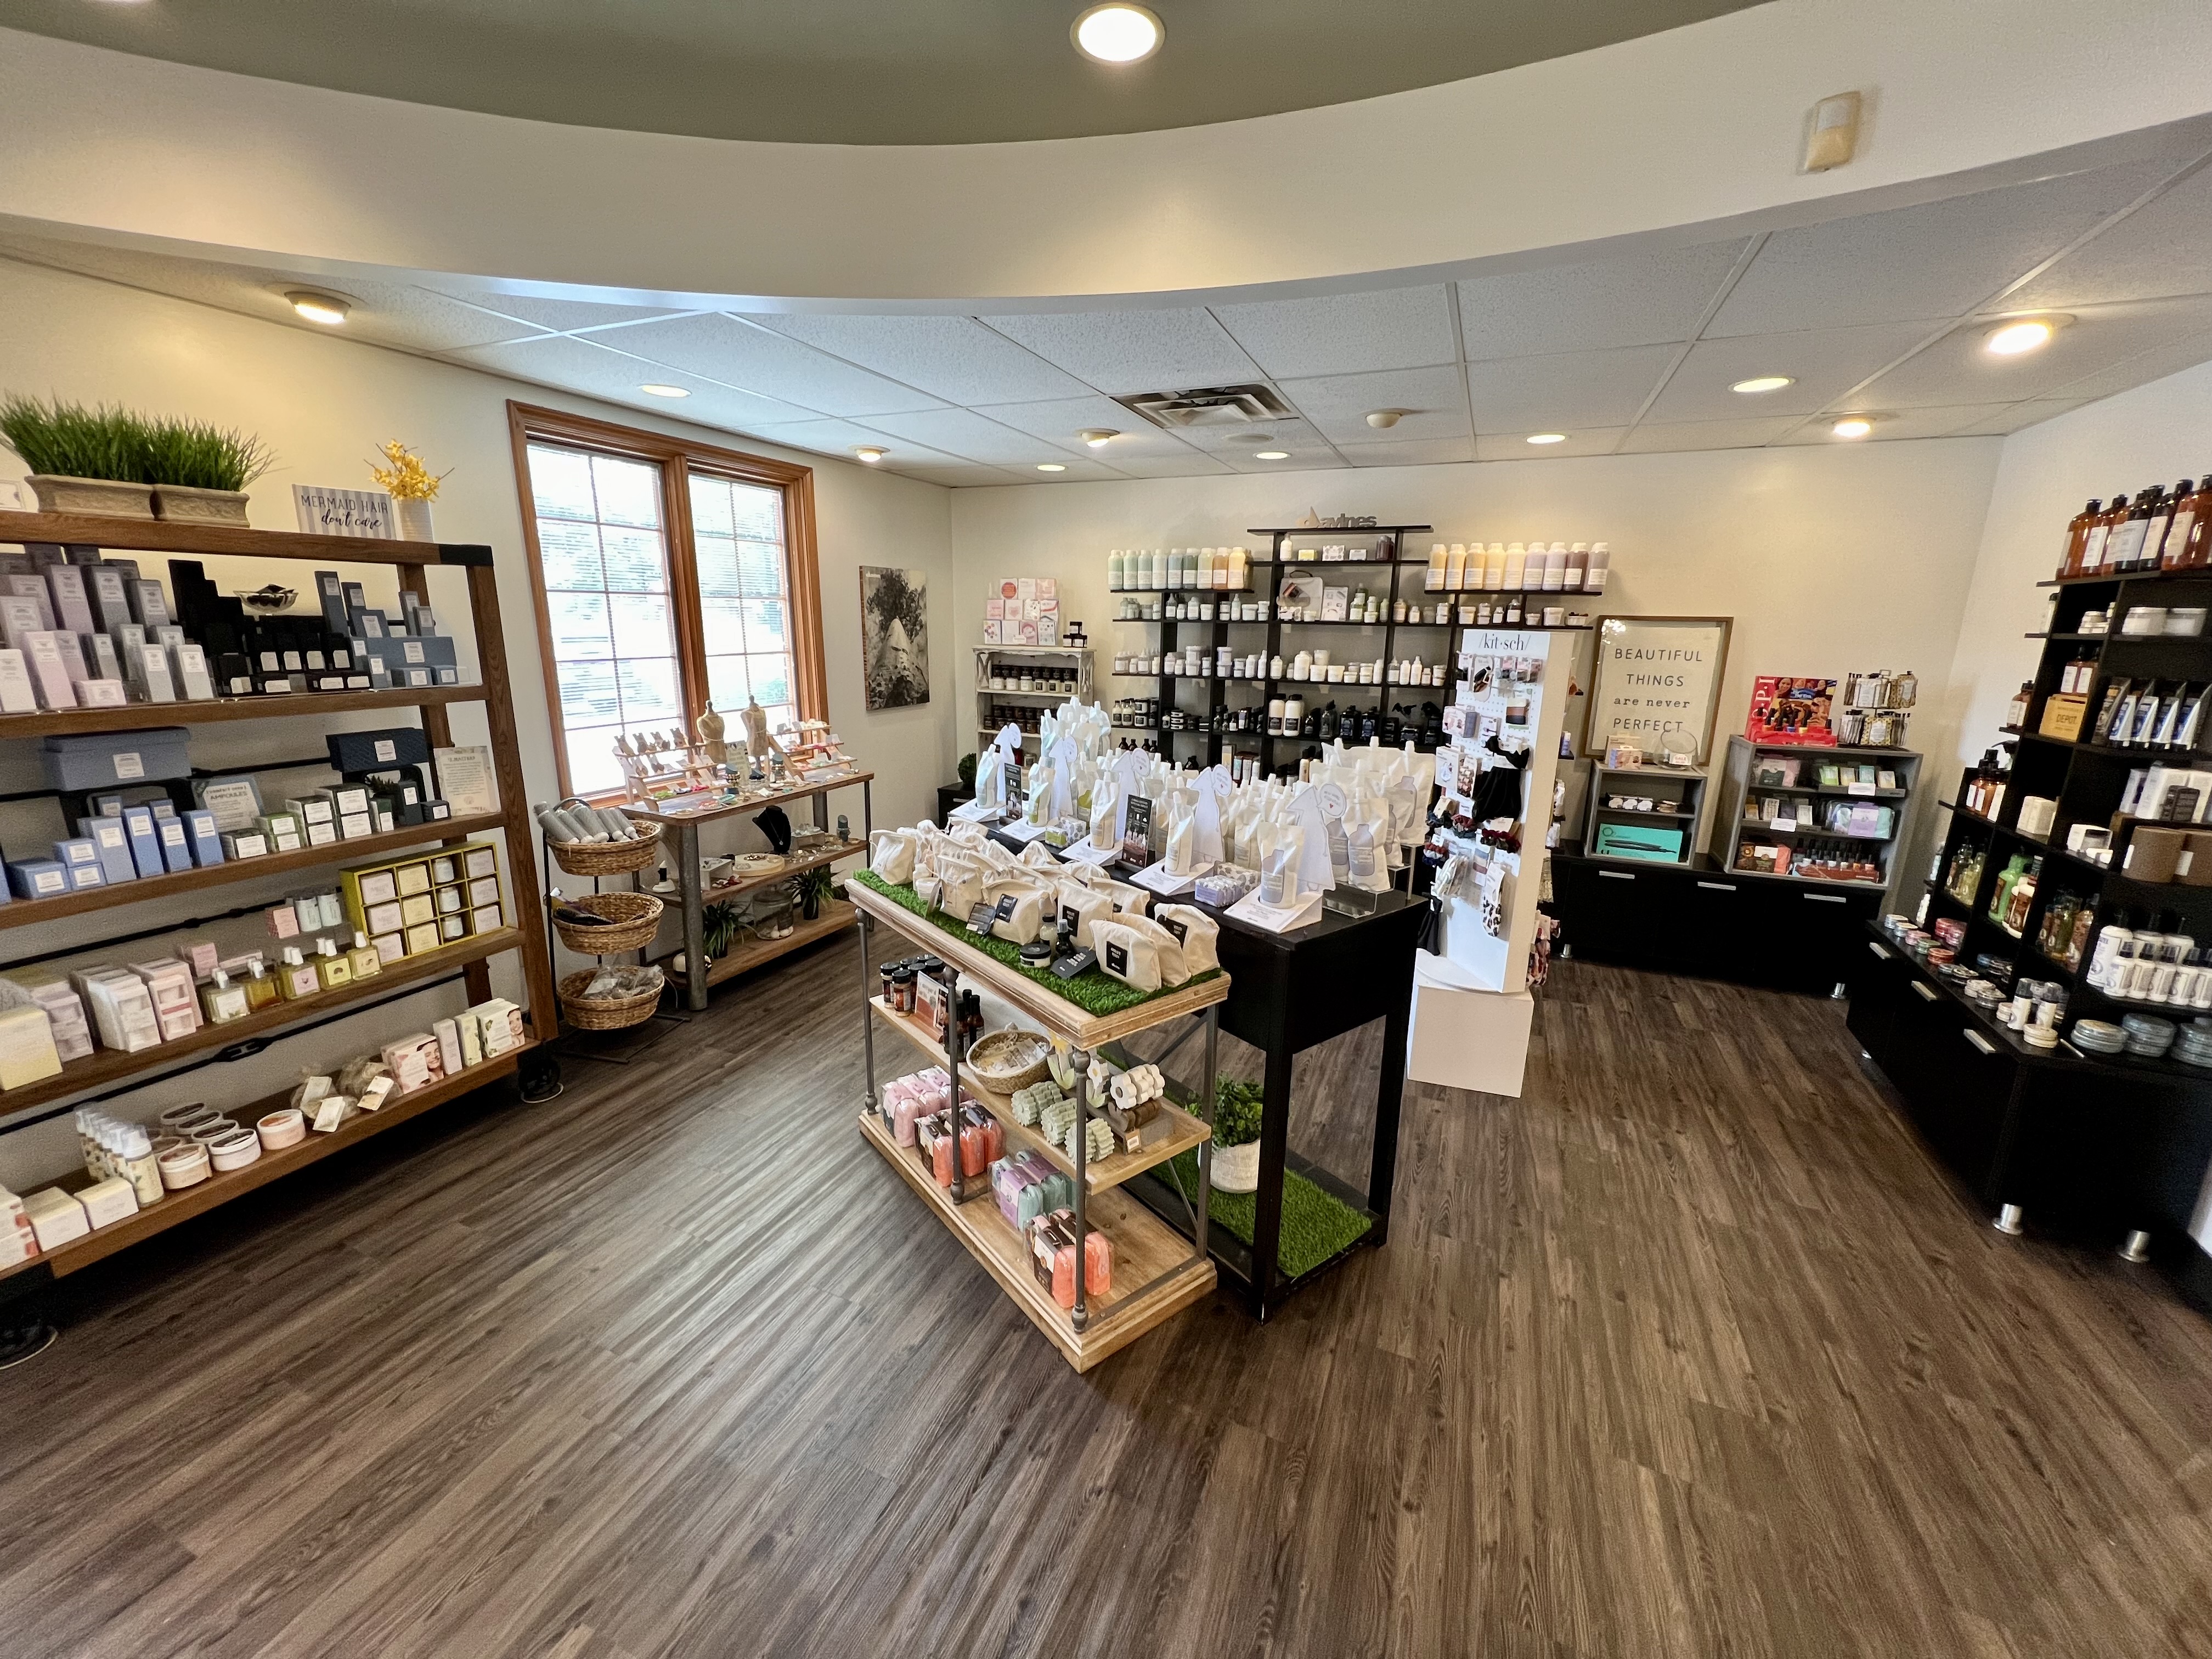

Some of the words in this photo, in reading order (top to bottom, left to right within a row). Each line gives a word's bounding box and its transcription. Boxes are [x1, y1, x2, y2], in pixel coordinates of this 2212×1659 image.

[301, 495, 356, 511] MERMAID
[361, 500, 388, 514] HAIR
[355, 517, 382, 530] care
[1296, 506, 1377, 528] davines
[1615, 648, 1702, 662] BEAUTIFUL
[1627, 674, 1684, 687] THINGS
[1646, 699, 1690, 708] never
[1613, 718, 1683, 733] PERFECT
